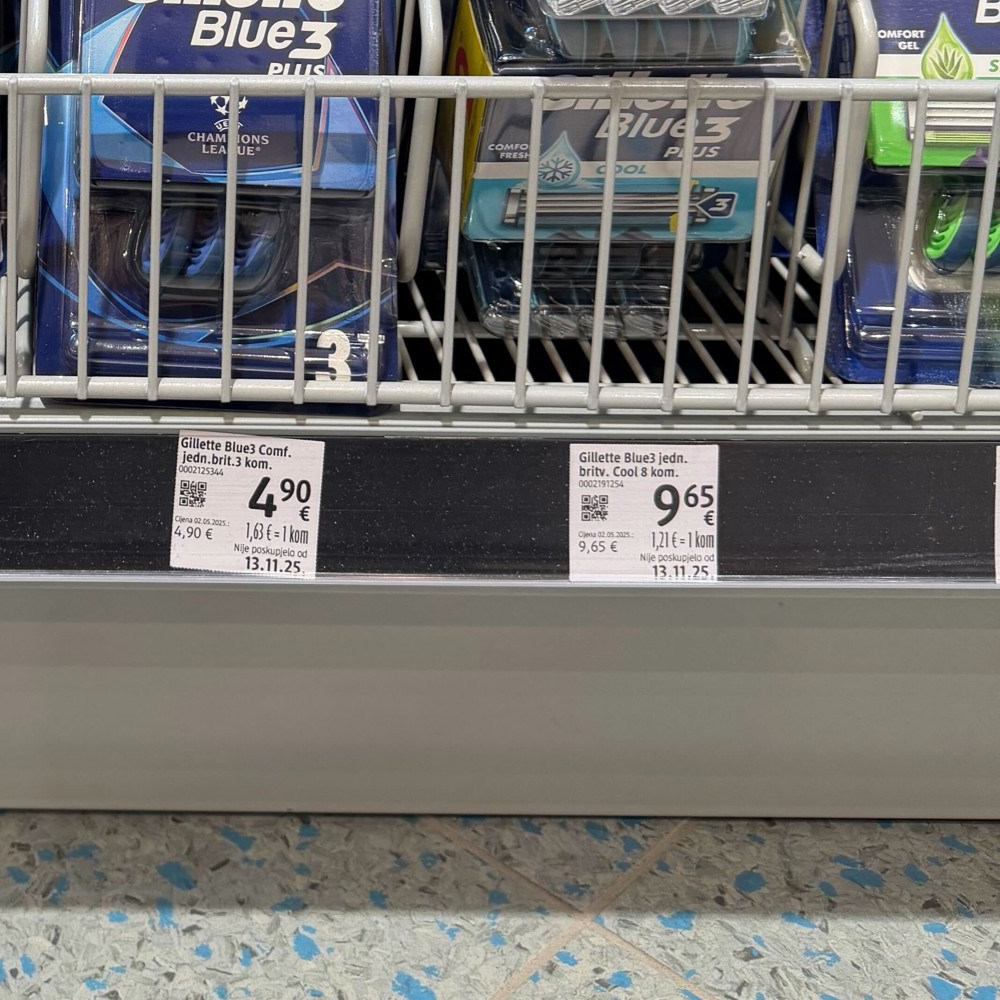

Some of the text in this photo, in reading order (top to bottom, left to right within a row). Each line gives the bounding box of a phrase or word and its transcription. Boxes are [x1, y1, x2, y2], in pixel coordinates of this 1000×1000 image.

[190, 10, 338, 60] Blue3
[878, 30, 925, 38] OMFORT
[898, 42, 919, 50] GEL
[188, 132, 270, 145] CHAMIONS
[181, 437, 291, 457] Gillette Blue3 Comf.
[245, 457, 272, 469] kom.
[579, 452, 687, 465] Gillette Blue3 jedn.
[580, 466, 678, 477] britv. Cool 8 kom.
